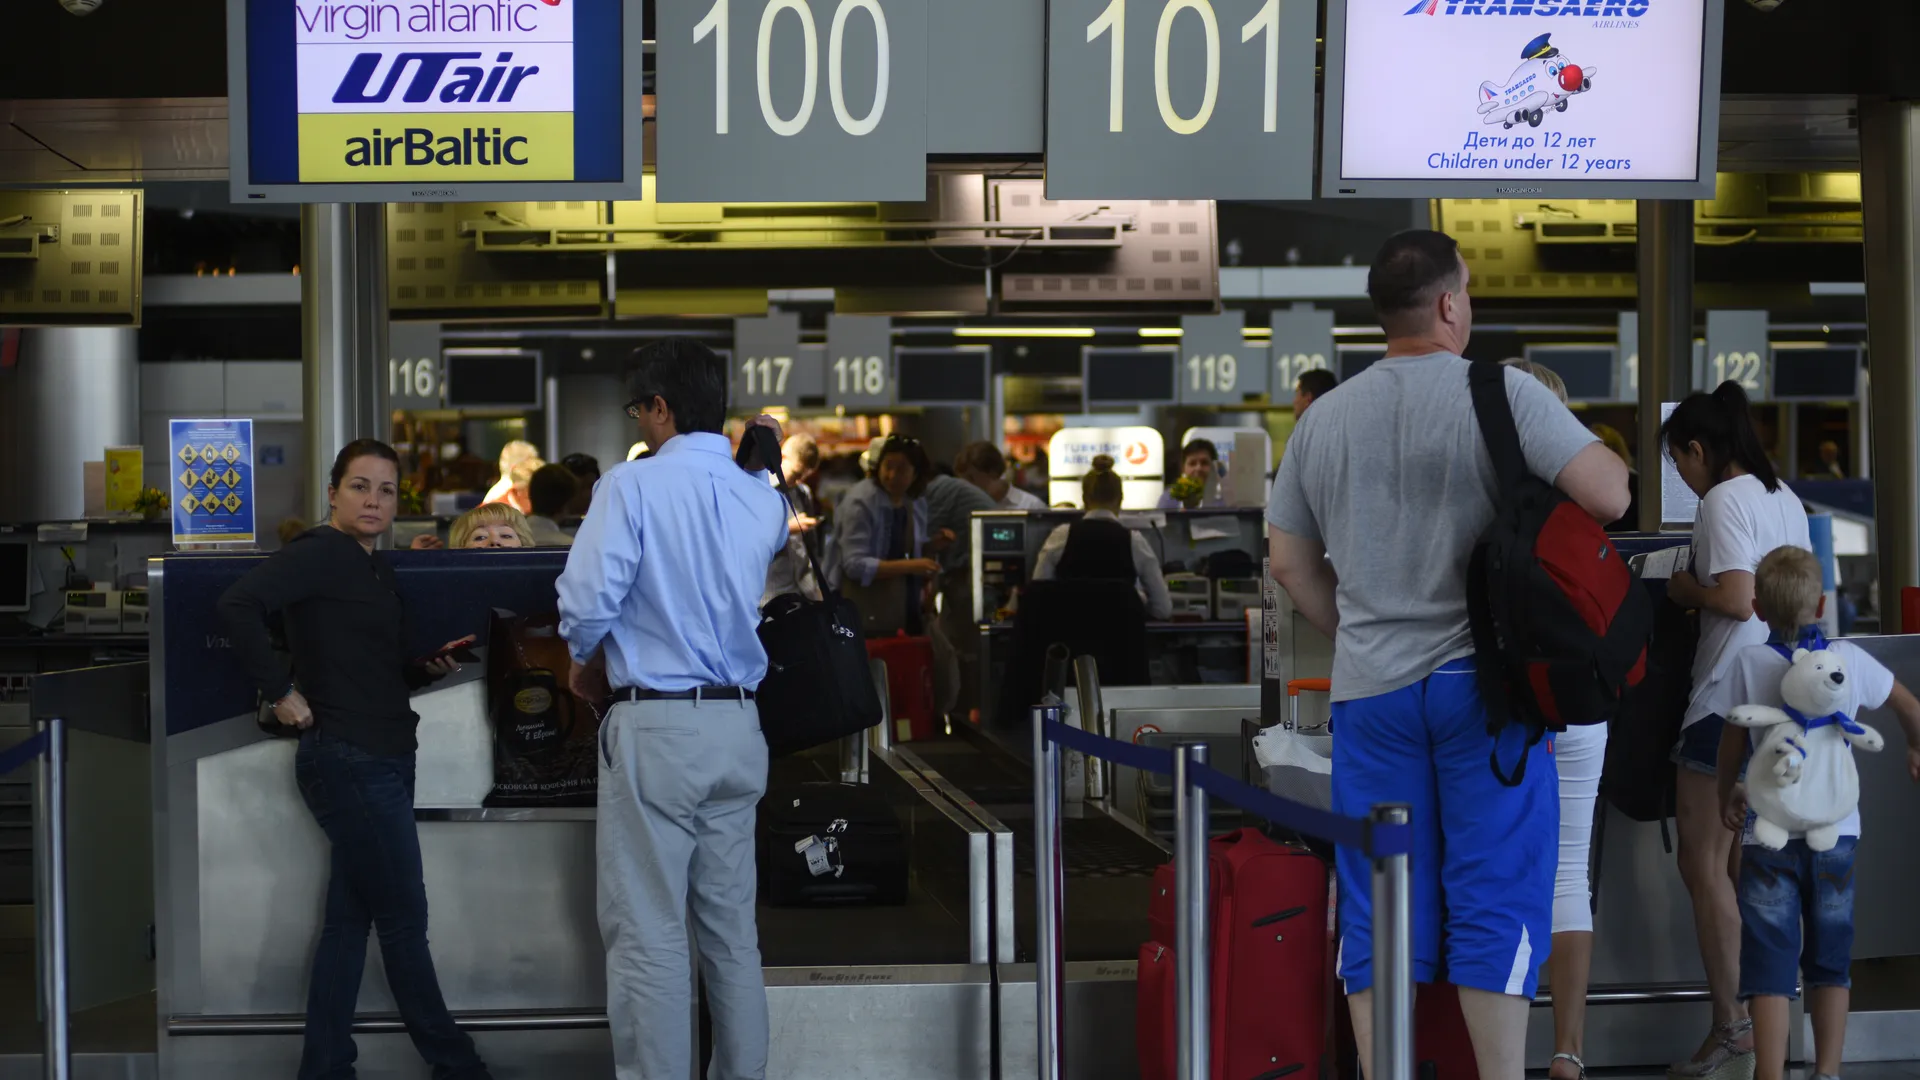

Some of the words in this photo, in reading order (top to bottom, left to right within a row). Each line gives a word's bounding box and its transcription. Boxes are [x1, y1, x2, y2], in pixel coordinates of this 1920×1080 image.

[296, 0, 400, 40] virgin
[408, 0, 538, 33] atlantic
[1444, 0, 1650, 18] TRANSAERO
[1592, 20, 1640, 29] AIRLINES
[331, 52, 540, 103] UTair
[693, 0, 890, 136] 100
[1086, 0, 1279, 135] 101
[1505, 73, 1536, 95] TRANSAERO
[344, 128, 529, 167] airBaltic
[1463, 132, 1508, 150] Дети
[1512, 137, 1535, 150] до
[1543, 132, 1562, 148] 12
[1566, 137, 1596, 148] лет
[1427, 152, 1498, 169] Children
[1504, 153, 1553, 169] under
[1561, 154, 1580, 169] 12
[1584, 158, 1631, 173] years
[389, 357, 435, 397] 116
[742, 357, 792, 396] 117
[834, 356, 884, 396] 118
[1188, 354, 1237, 392] 119
[1713, 351, 1760, 389] 122
